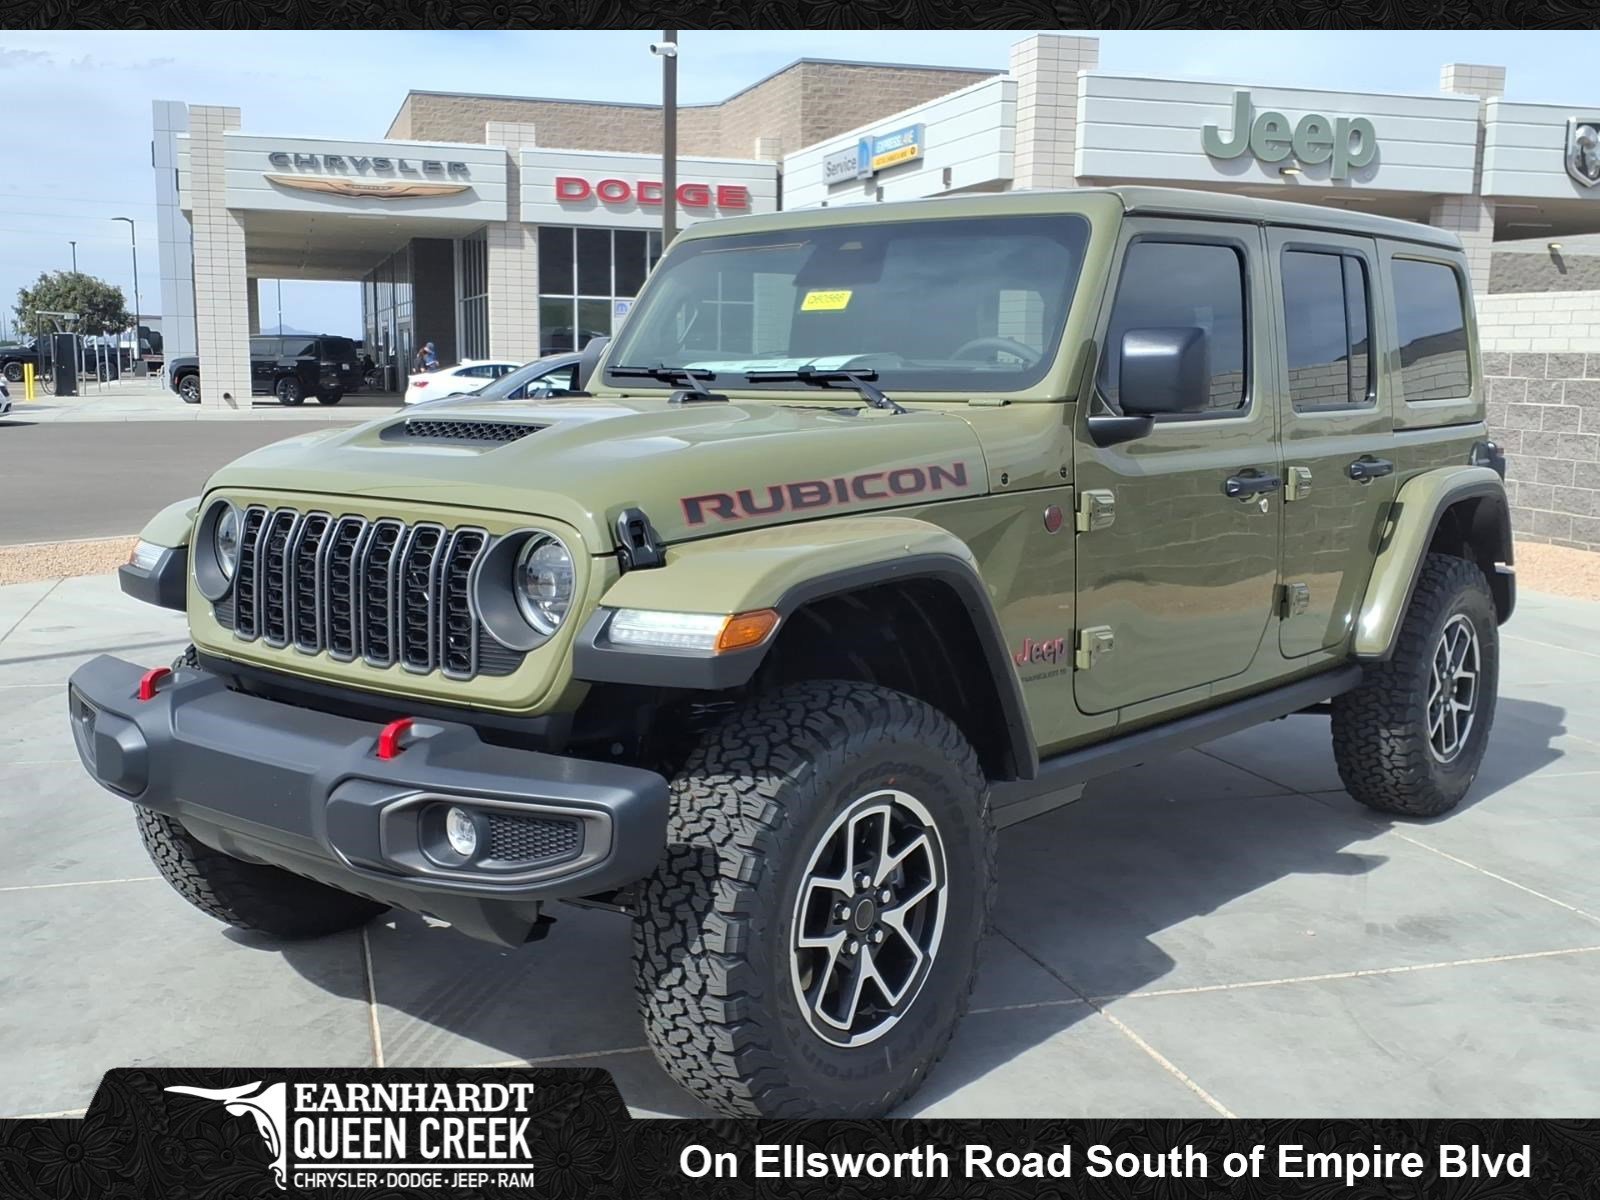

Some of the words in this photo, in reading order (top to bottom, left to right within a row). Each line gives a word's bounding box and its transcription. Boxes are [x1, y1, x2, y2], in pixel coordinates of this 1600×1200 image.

[1201, 91, 1377, 180] Jeep
[268, 151, 470, 176] CHRYSLER
[826, 156, 857, 177] Service
[556, 177, 748, 209] DODGE
[680, 462, 968, 527] RUBICON
[1014, 637, 1065, 667] Jeep
